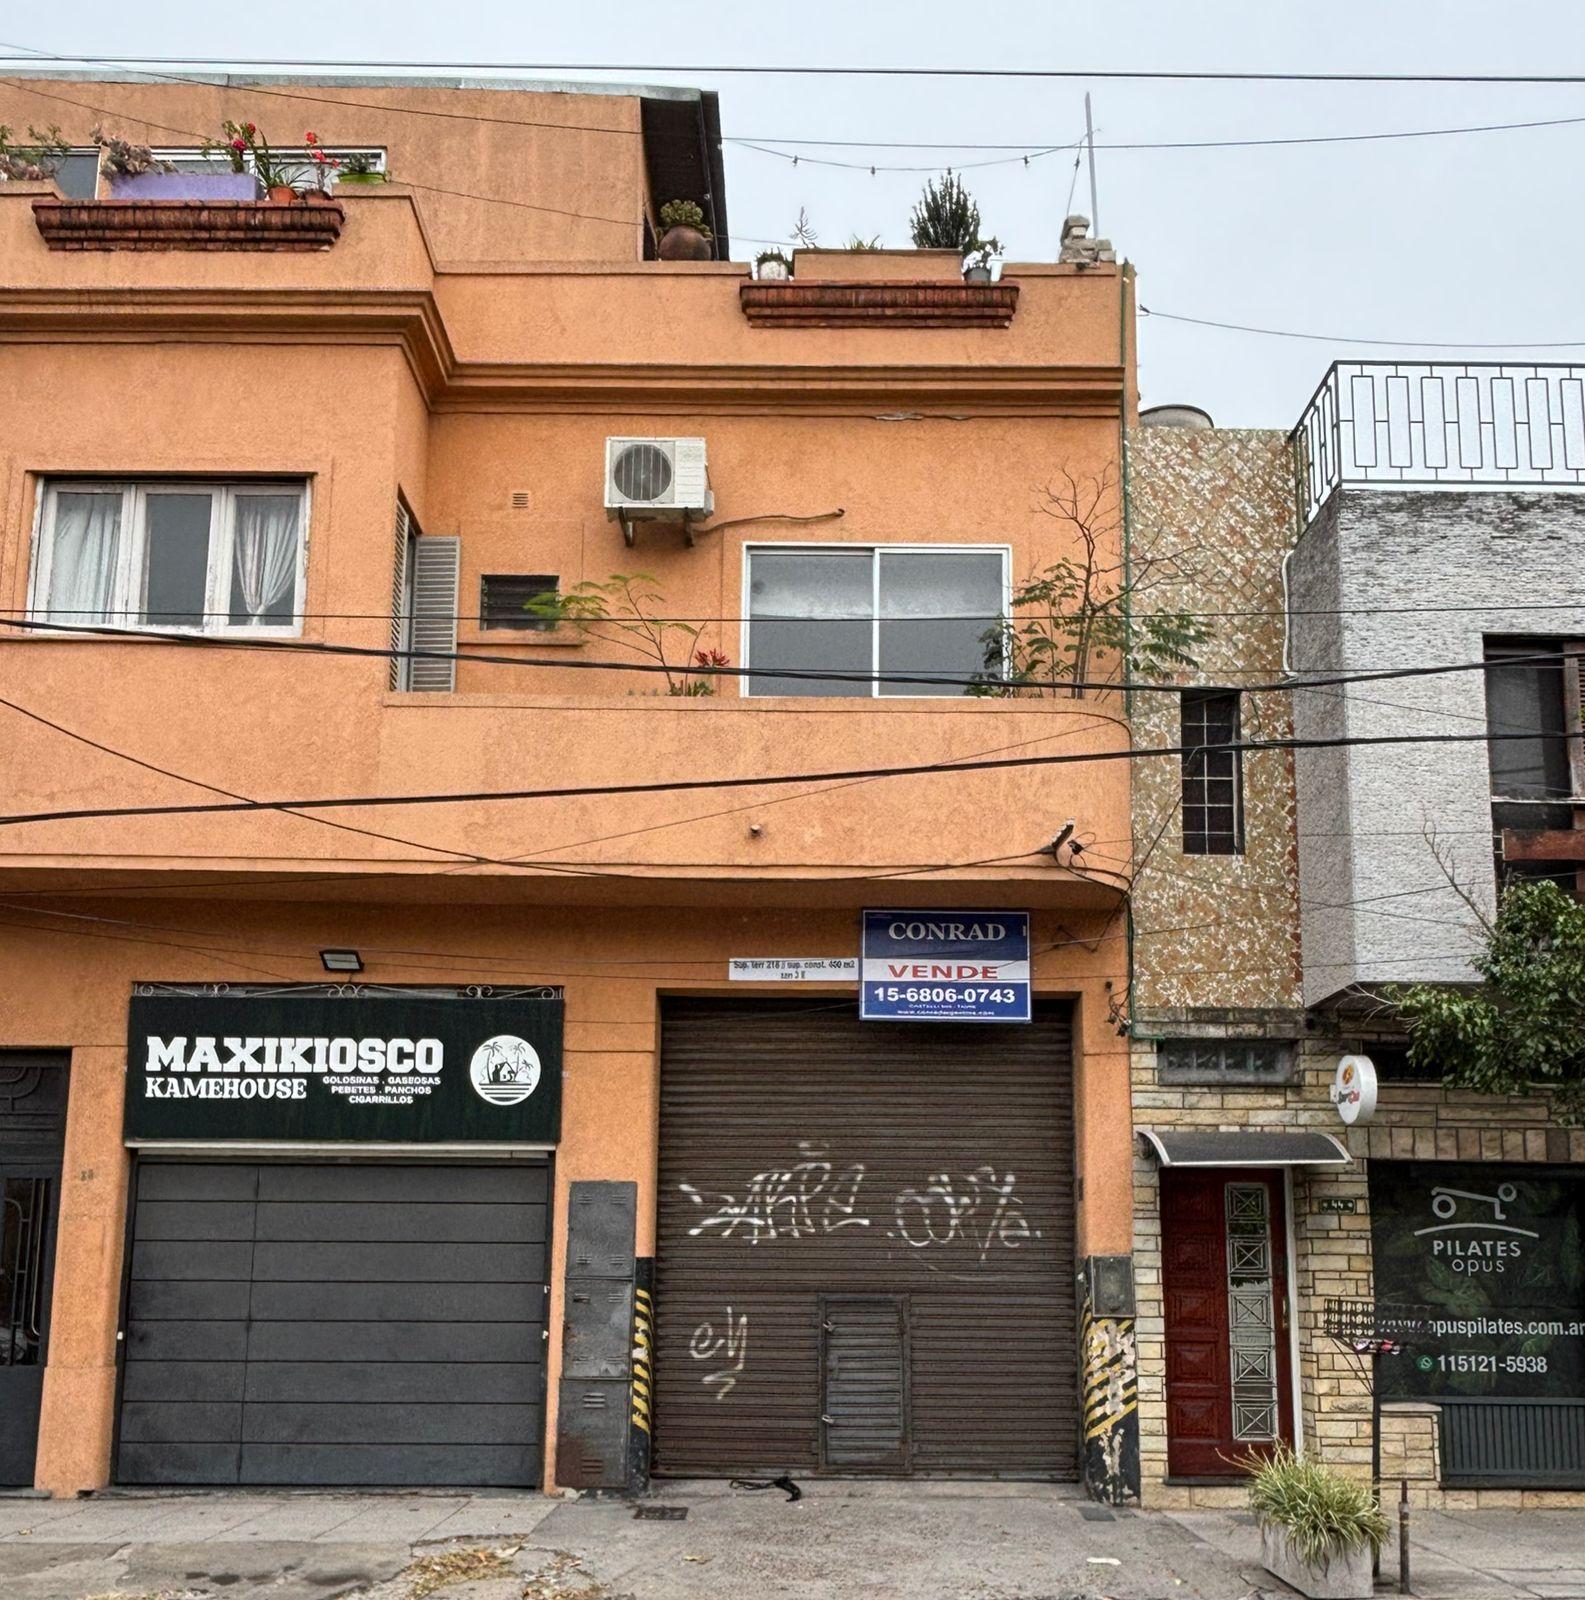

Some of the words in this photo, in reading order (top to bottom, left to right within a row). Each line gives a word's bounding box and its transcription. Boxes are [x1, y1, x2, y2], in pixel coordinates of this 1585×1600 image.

[887, 922, 1006, 941] CONRAD
[887, 964, 998, 979] VENDE
[874, 987, 1016, 1004] 15-6806-0743
[145, 1036, 444, 1073] MAXIKIOSCO
[145, 1077, 307, 1099] KAMEHOUSE
[322, 1076, 380, 1084] GOLOSINAS
[331, 1085, 376, 1094] PEBETES
[384, 1086, 432, 1095] PANCHOS
[348, 1095, 414, 1104] CIGARRILLOS
[1433, 1240, 1521, 1257] PILATES
[1451, 1259, 1505, 1277] opus
[1377, 1317, 1585, 1338] opuspilates.com.ar
[1437, 1355, 1548, 1373] 115121-5938
